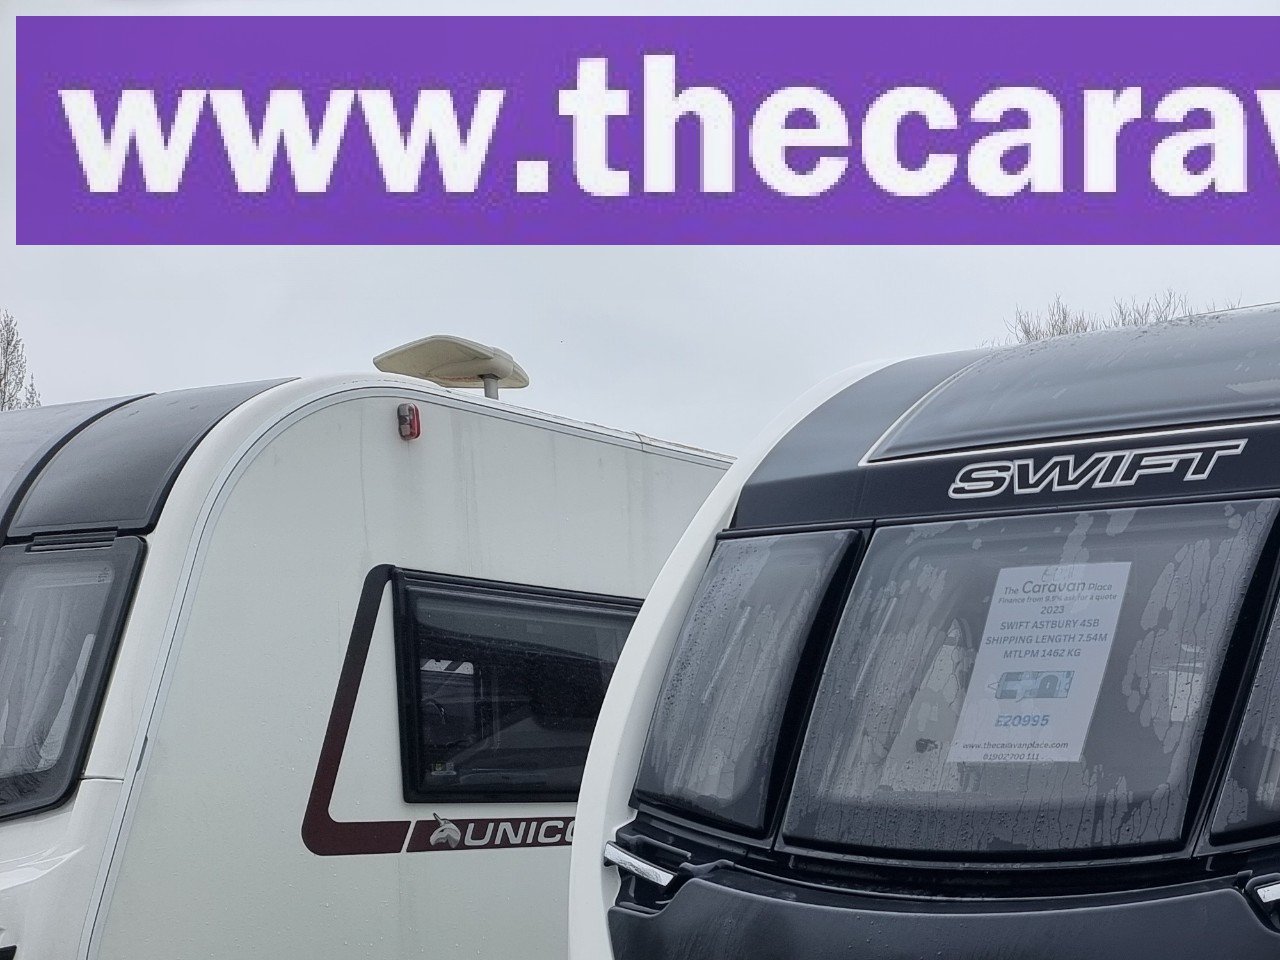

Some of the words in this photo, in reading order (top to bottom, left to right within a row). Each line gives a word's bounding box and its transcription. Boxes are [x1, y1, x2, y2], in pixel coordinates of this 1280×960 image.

[948, 438, 1248, 499] SWIFT
[1004, 587, 1019, 595] The
[1022, 580, 1087, 594] Caravan
[1088, 582, 1113, 591] Place
[1040, 605, 1065, 614] 2023
[1000, 621, 1030, 630] SWIFT
[1031, 619, 1079, 629] ASTBURY
[1079, 618, 1100, 628] 4SB
[985, 635, 1033, 645] SHIPPING
[1035, 634, 1076, 644] LENGTH
[1078, 633, 1108, 643] 7.54M
[1003, 649, 1040, 659] MTLPM
[1040, 649, 1065, 658] 1462
[1066, 648, 1082, 657] KG
